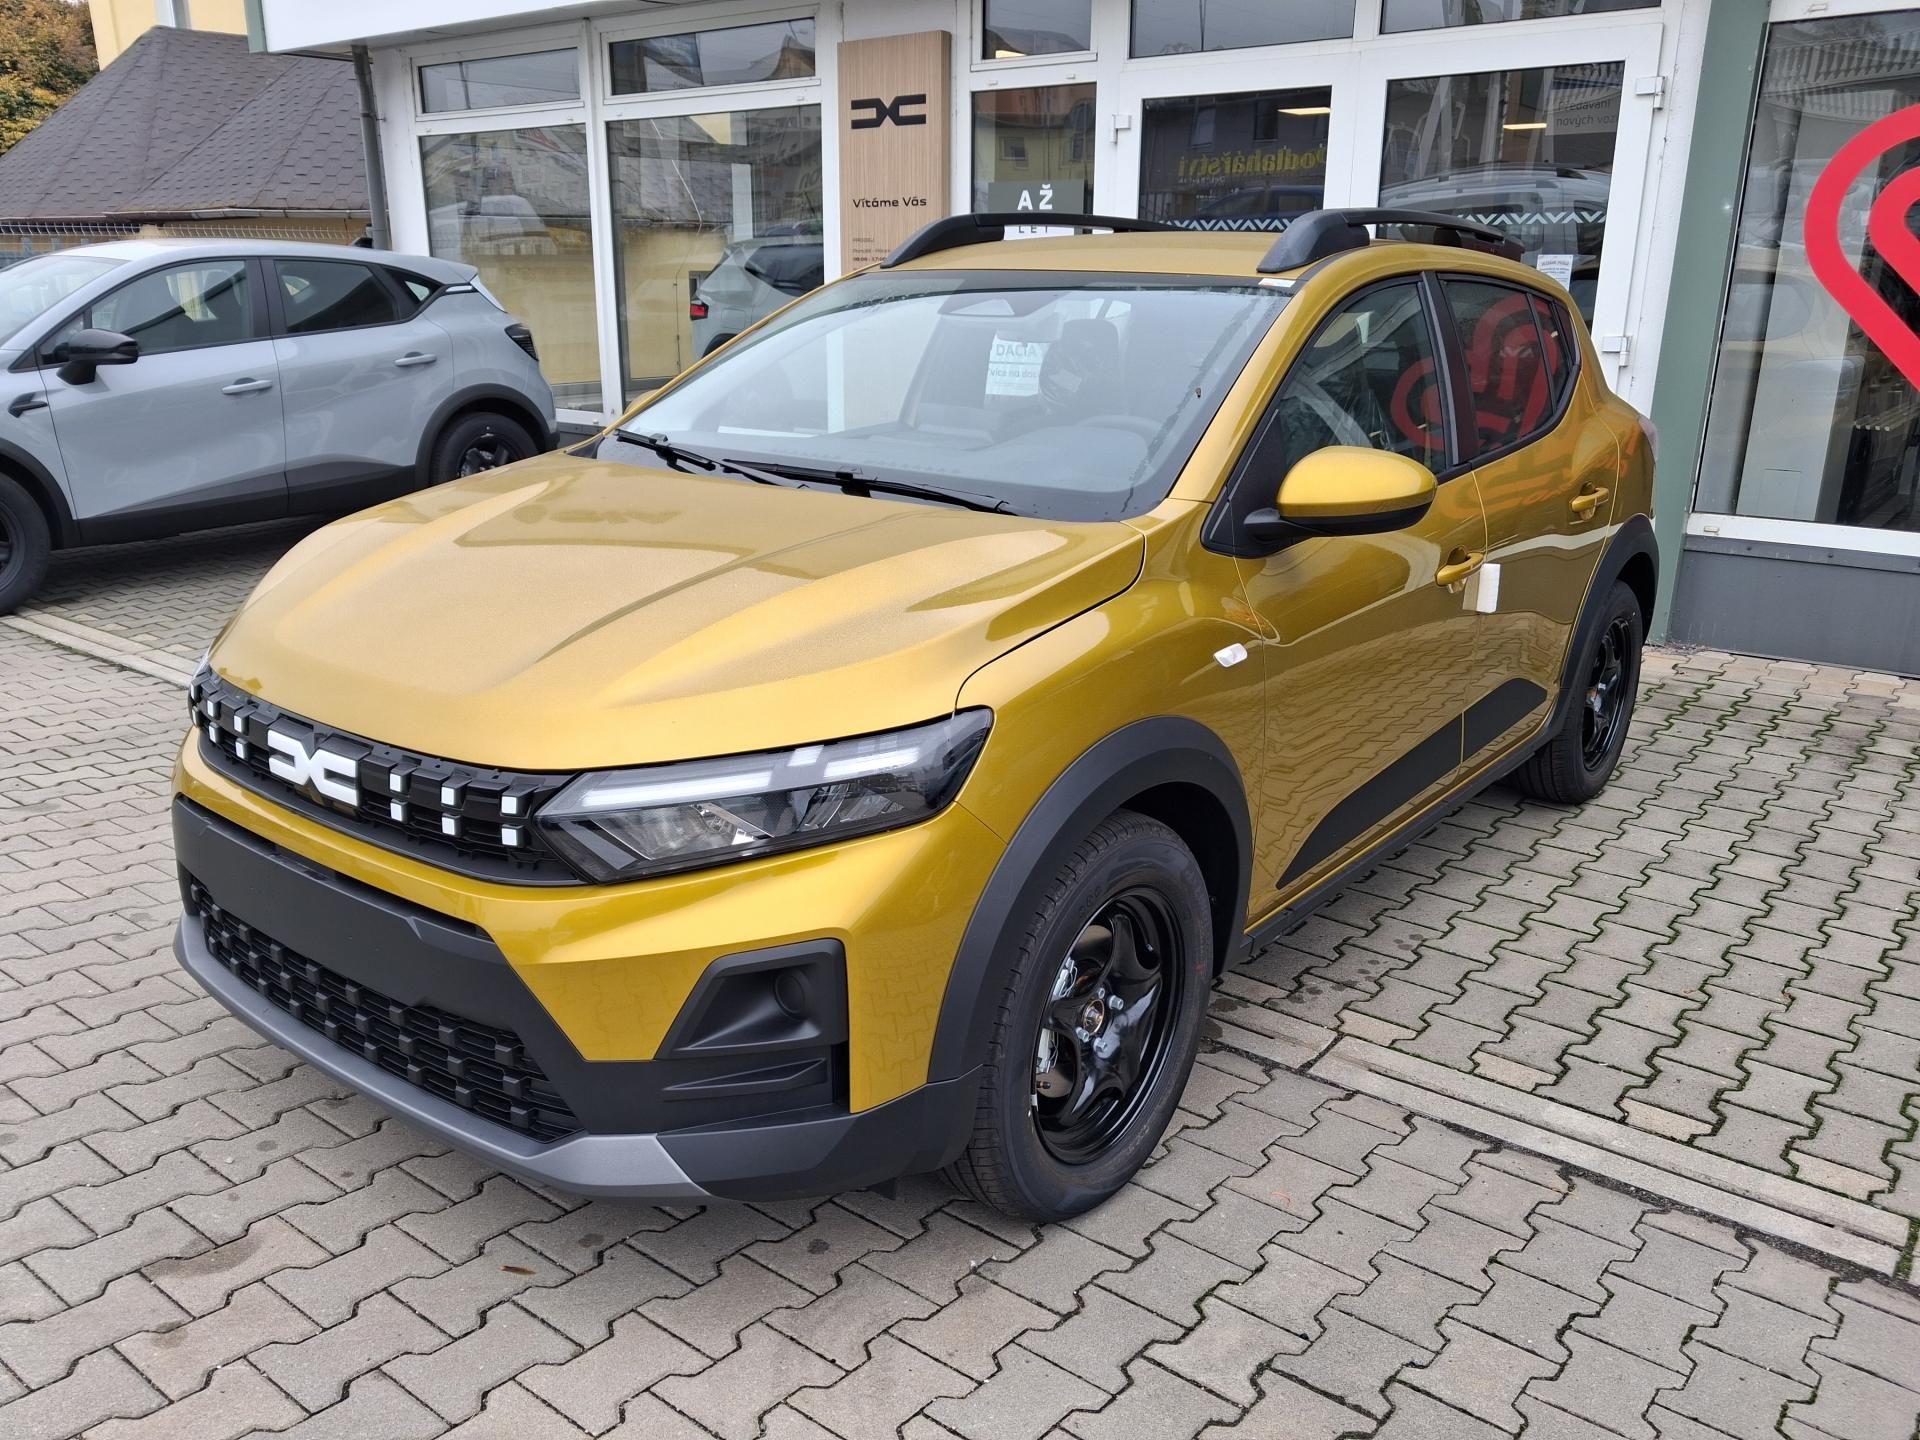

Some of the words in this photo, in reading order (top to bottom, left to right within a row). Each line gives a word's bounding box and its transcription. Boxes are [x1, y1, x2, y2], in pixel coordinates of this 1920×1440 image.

[1556, 115, 1594, 127] nových
[852, 196, 899, 208] Vítáme
[902, 195, 927, 207] Vás
[1017, 183, 1053, 211] AŽ
[996, 344, 1038, 357] DACIA
